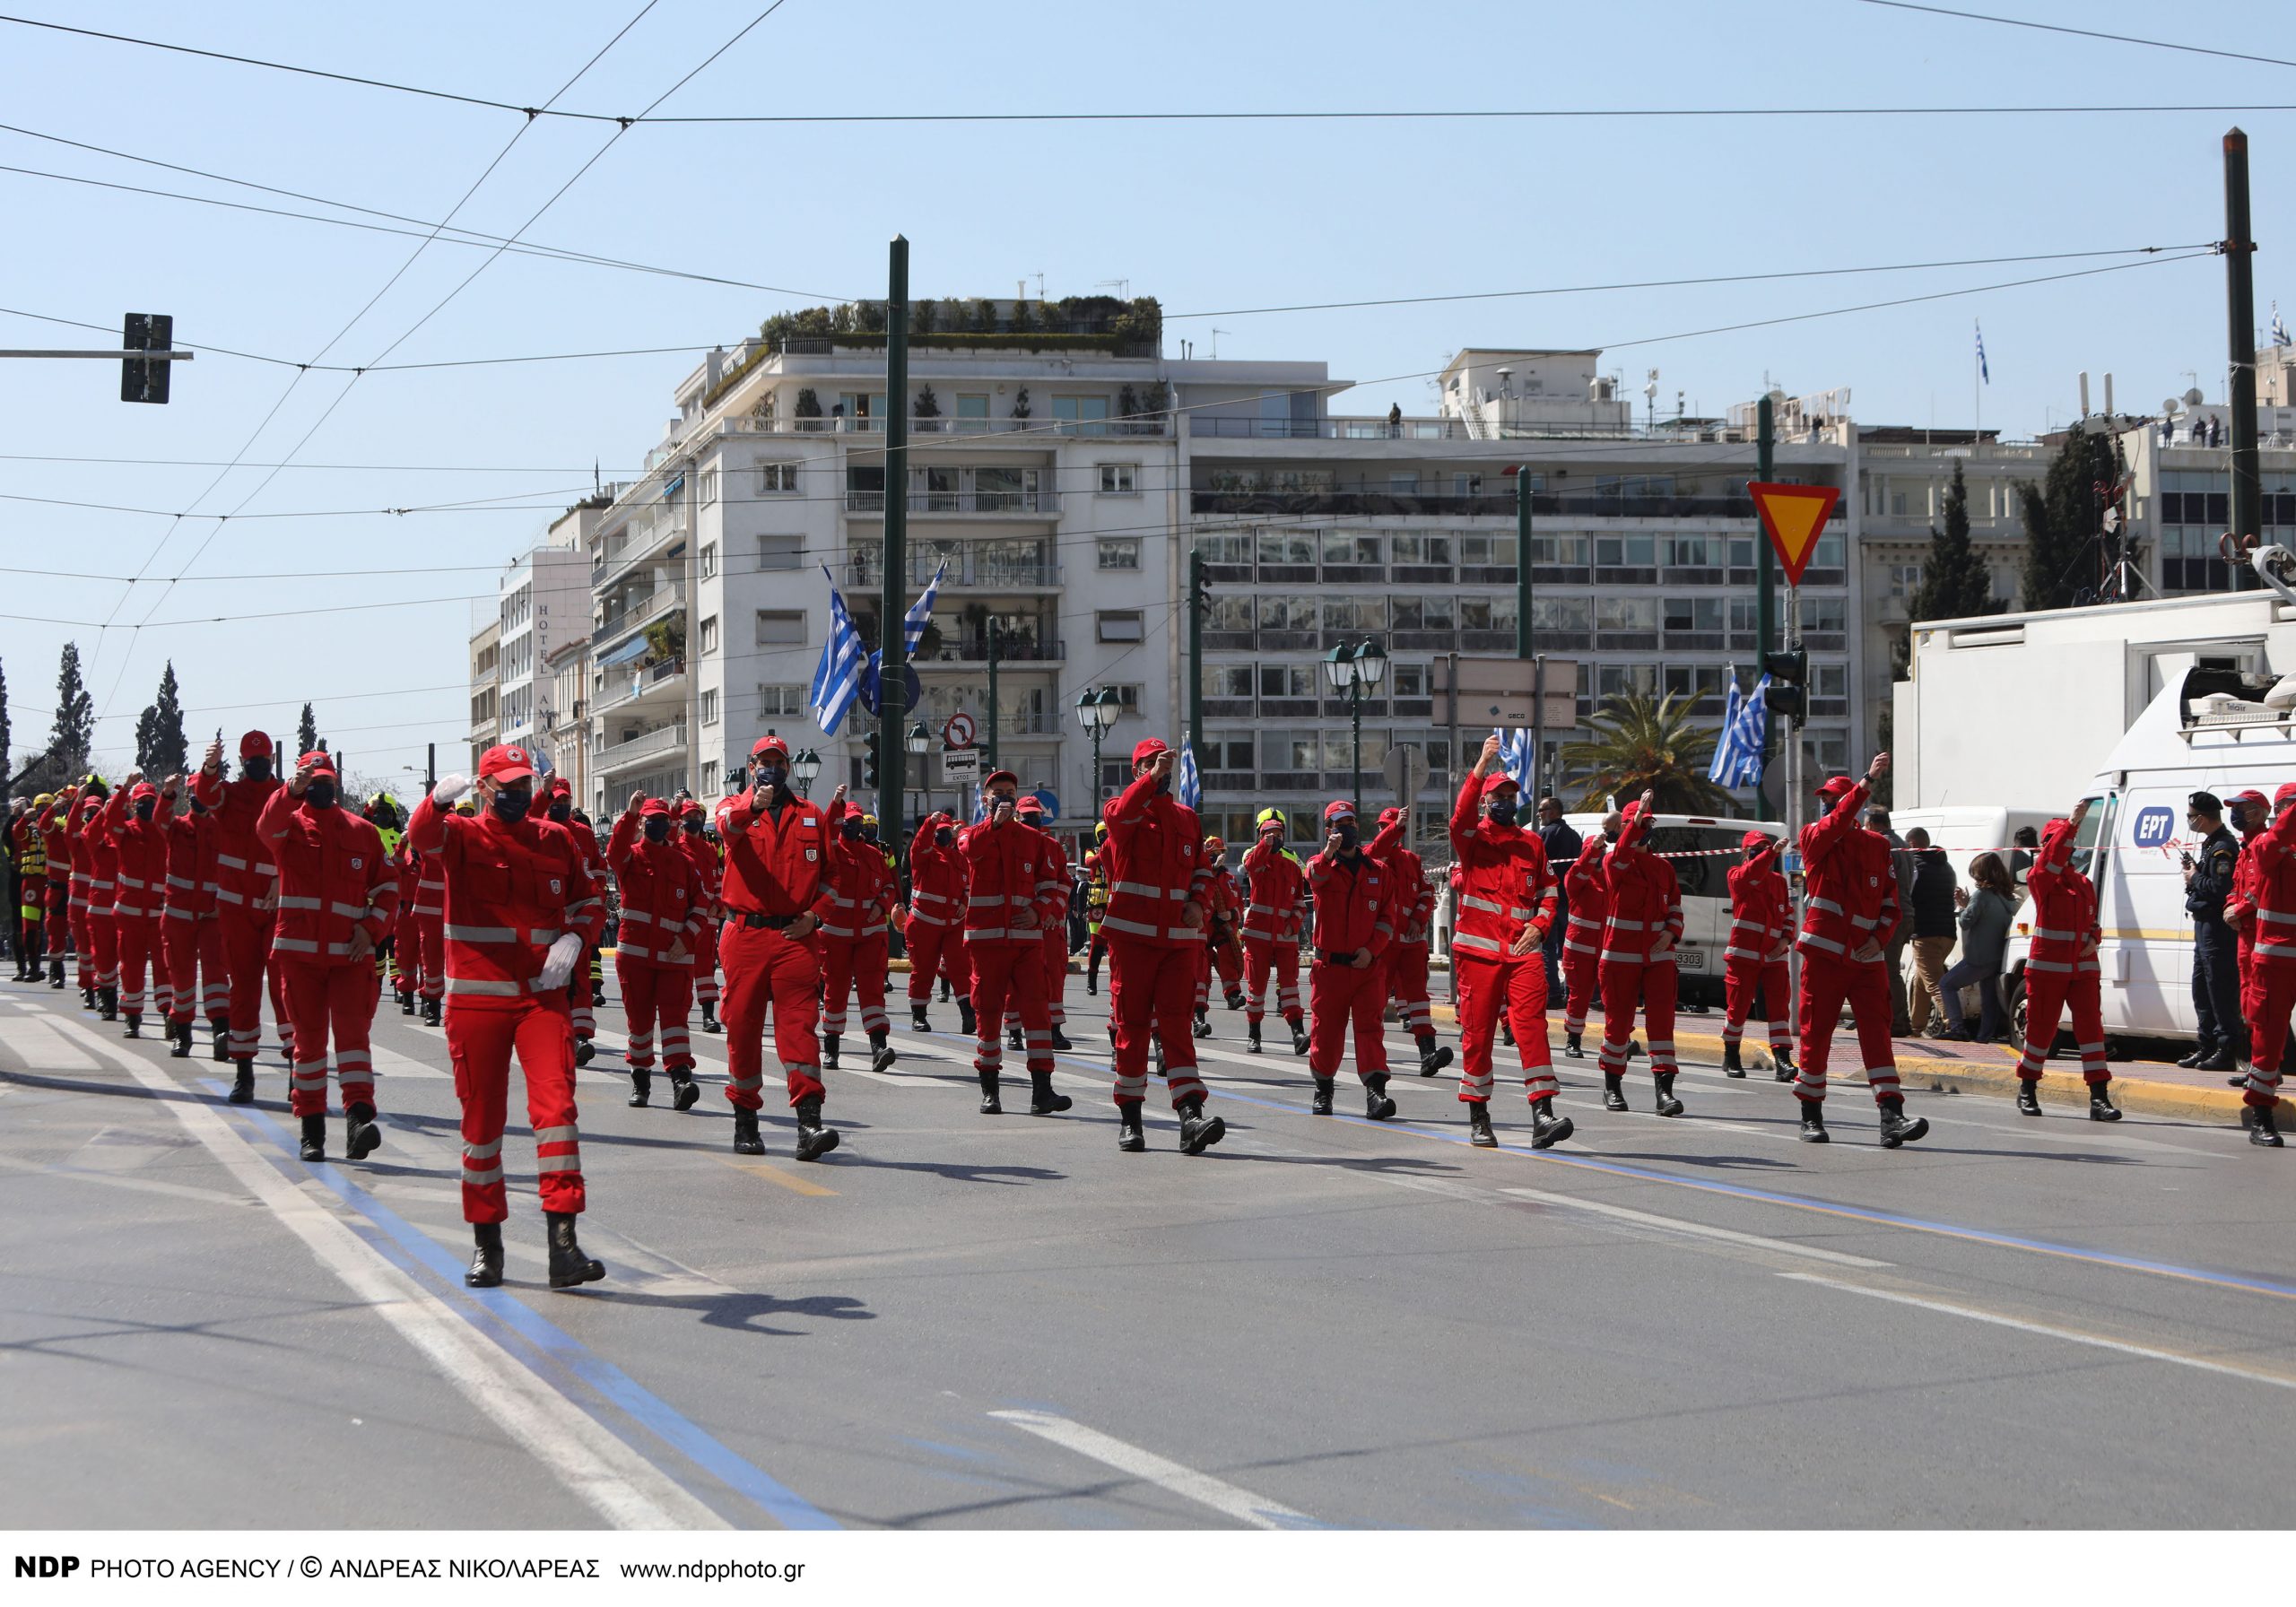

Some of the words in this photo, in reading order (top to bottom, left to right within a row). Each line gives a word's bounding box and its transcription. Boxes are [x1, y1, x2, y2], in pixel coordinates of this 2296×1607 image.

[539, 605, 548, 673] HOTEL
[2139, 814, 2169, 838] ΕΡΤ
[1675, 953, 1700, 964] 9303
